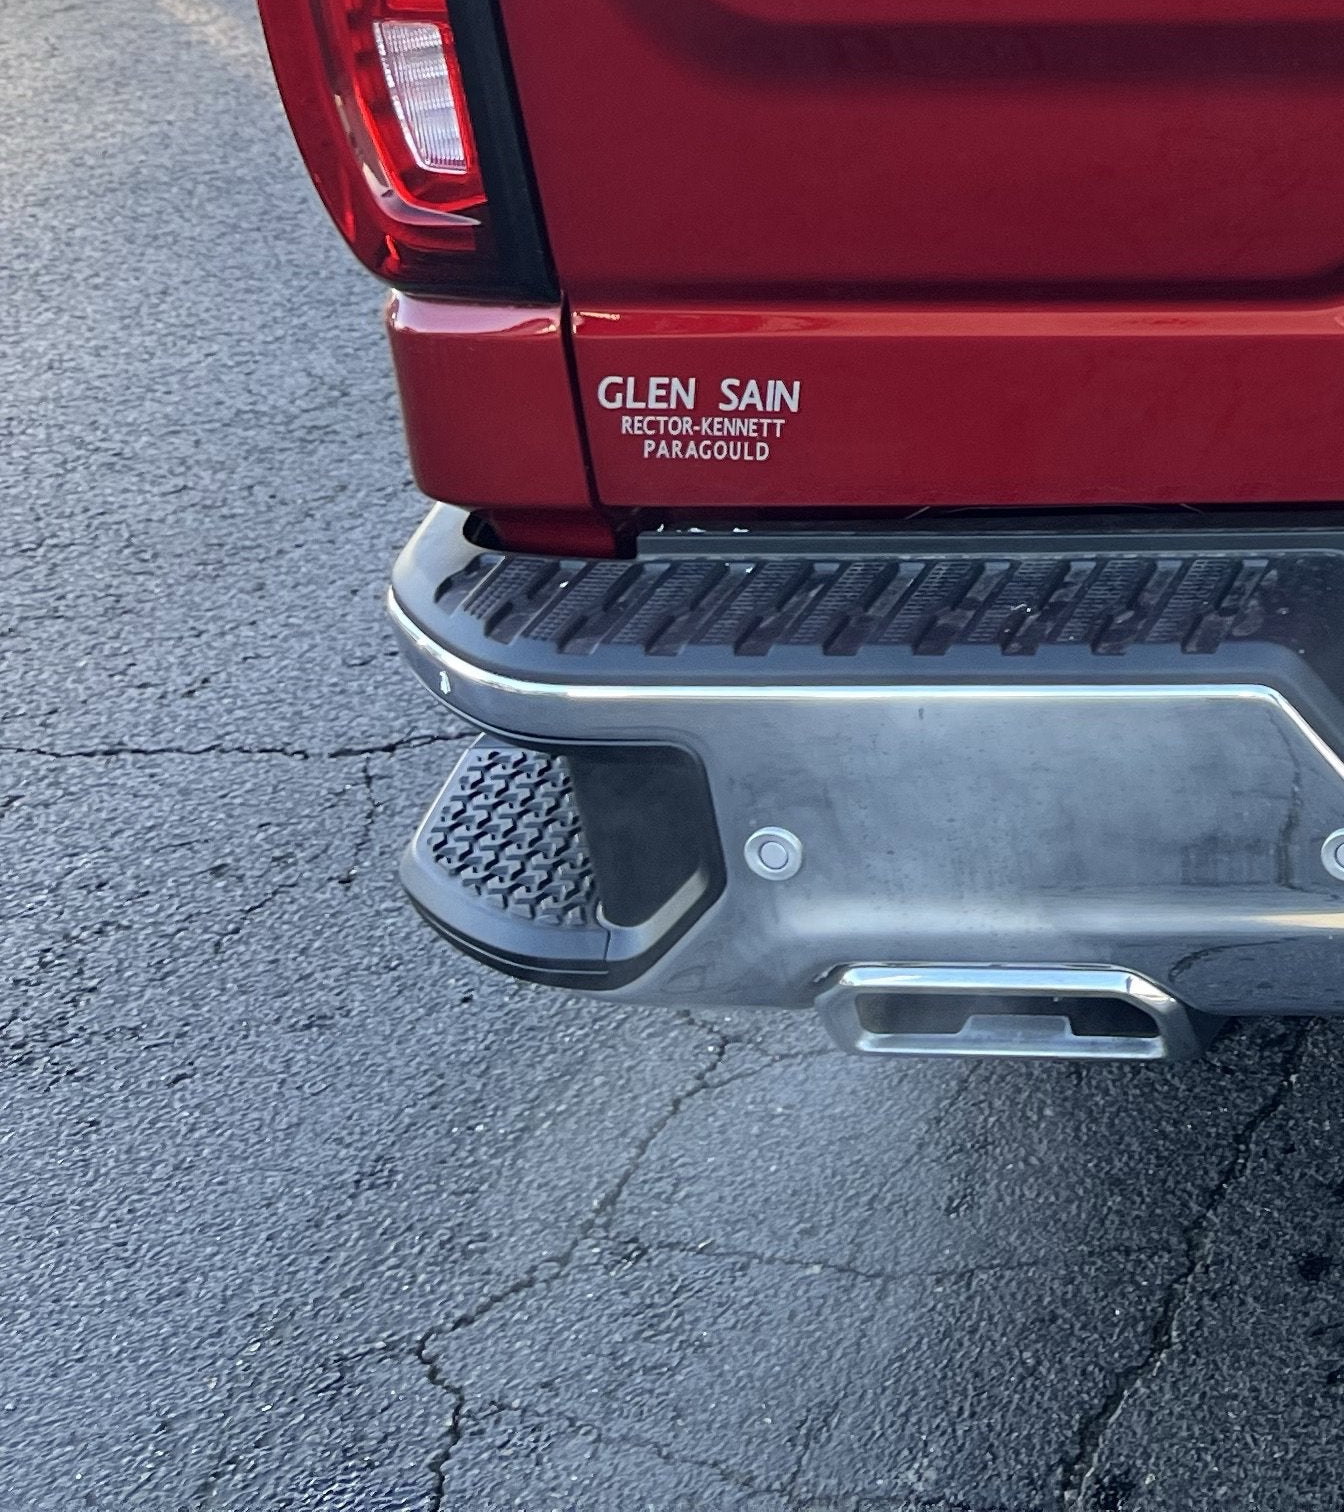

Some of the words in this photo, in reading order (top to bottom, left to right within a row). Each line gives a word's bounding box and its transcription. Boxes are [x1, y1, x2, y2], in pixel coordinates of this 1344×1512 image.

[597, 375, 696, 410] GLEN
[718, 378, 801, 413] SAIN
[621, 415, 786, 438] RECTOR-KENNETT
[643, 439, 770, 461] PARAGOULD
